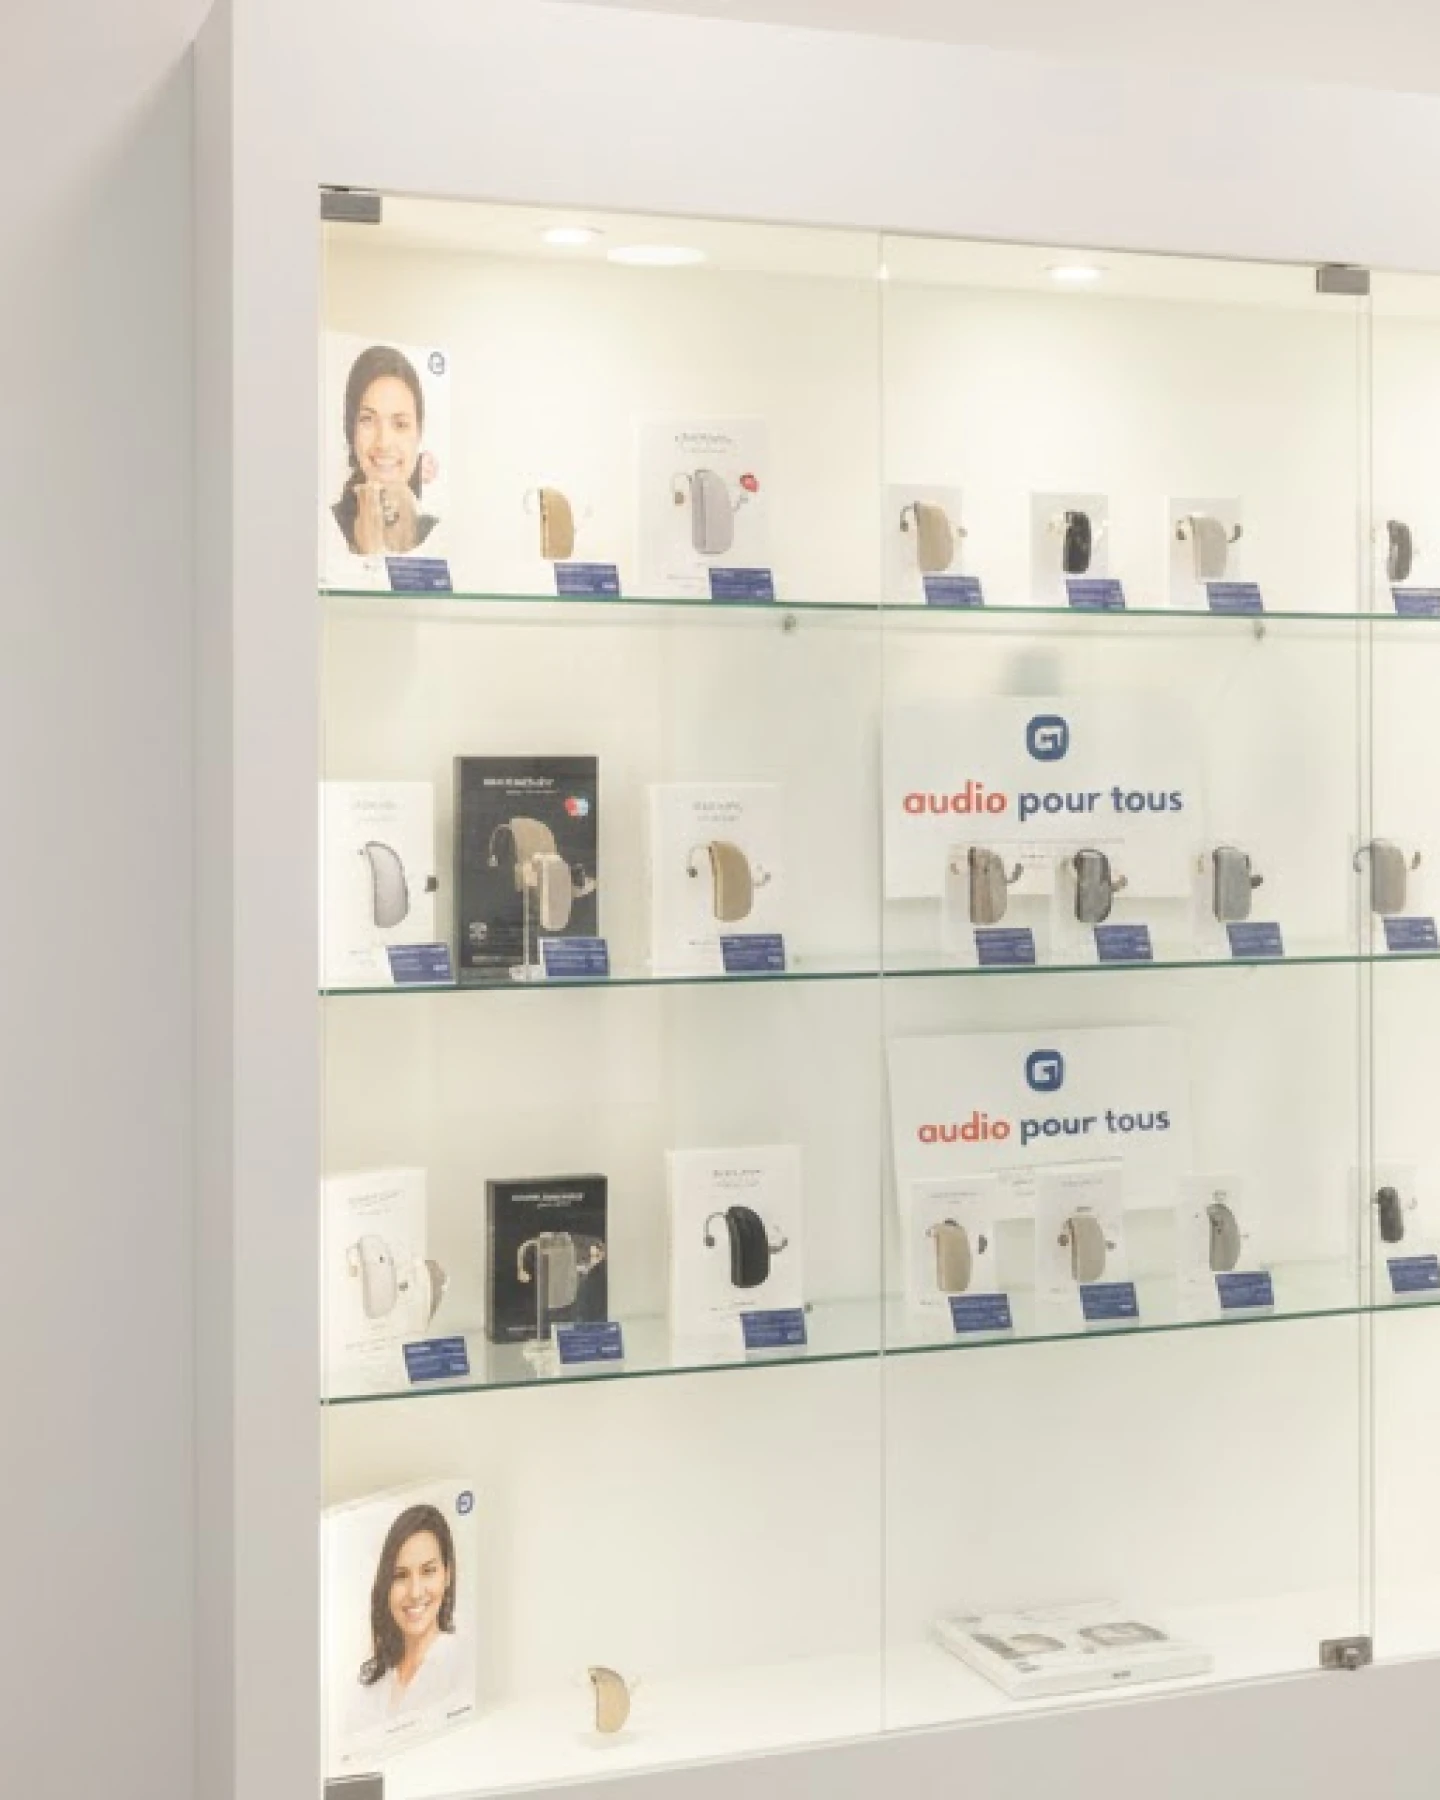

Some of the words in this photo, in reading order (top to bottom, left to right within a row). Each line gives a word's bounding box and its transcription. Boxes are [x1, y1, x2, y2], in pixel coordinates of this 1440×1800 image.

[903, 779, 1009, 815] audio
[1018, 790, 1101, 822] pour
[1110, 785, 1183, 815] tous
[917, 1111, 1010, 1144] audio
[1020, 1115, 1098, 1147] pour
[1104, 1108, 1171, 1133] tous
